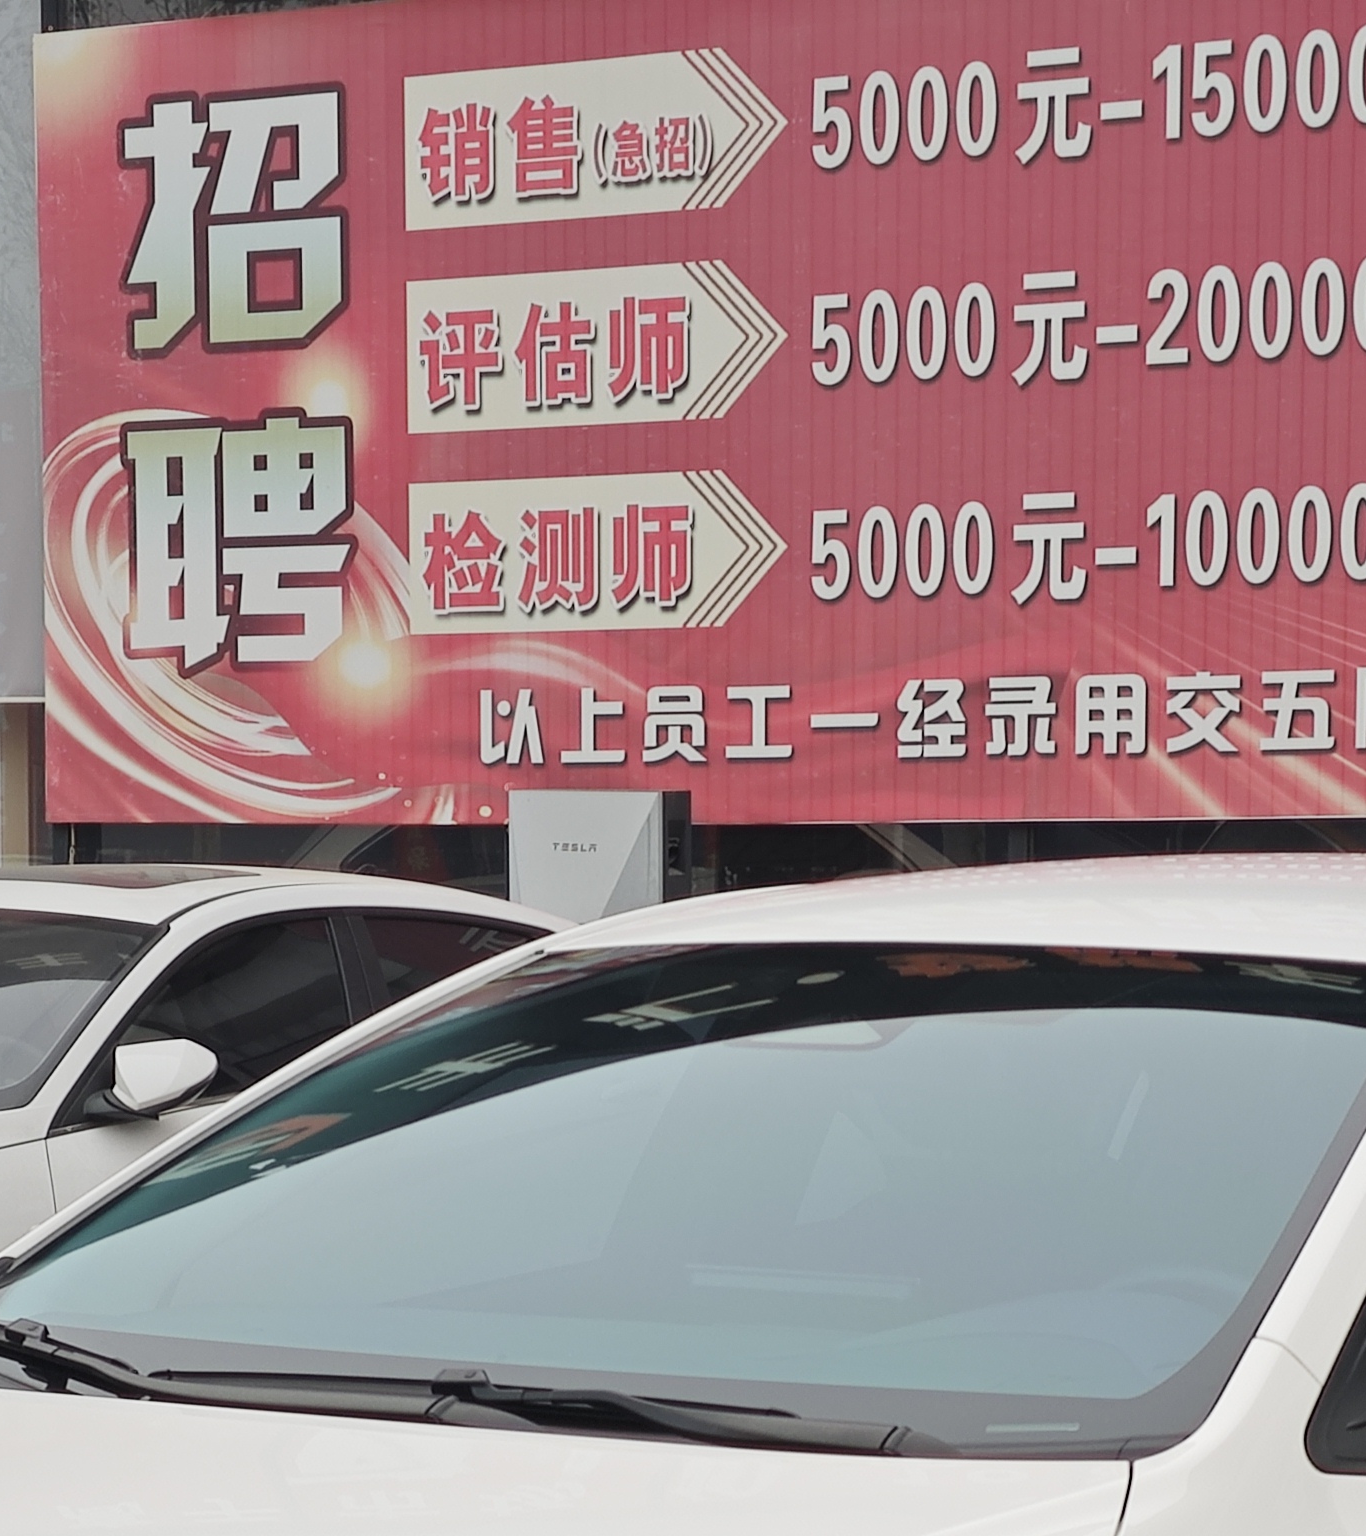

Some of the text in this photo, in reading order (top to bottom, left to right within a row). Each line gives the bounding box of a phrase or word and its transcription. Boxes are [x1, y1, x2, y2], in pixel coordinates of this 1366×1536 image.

[121, 88, 353, 674] 招聘
[420, 296, 692, 412] 评估师
[423, 504, 695, 617] 检测师
[552, 842, 597, 853] TESLA
